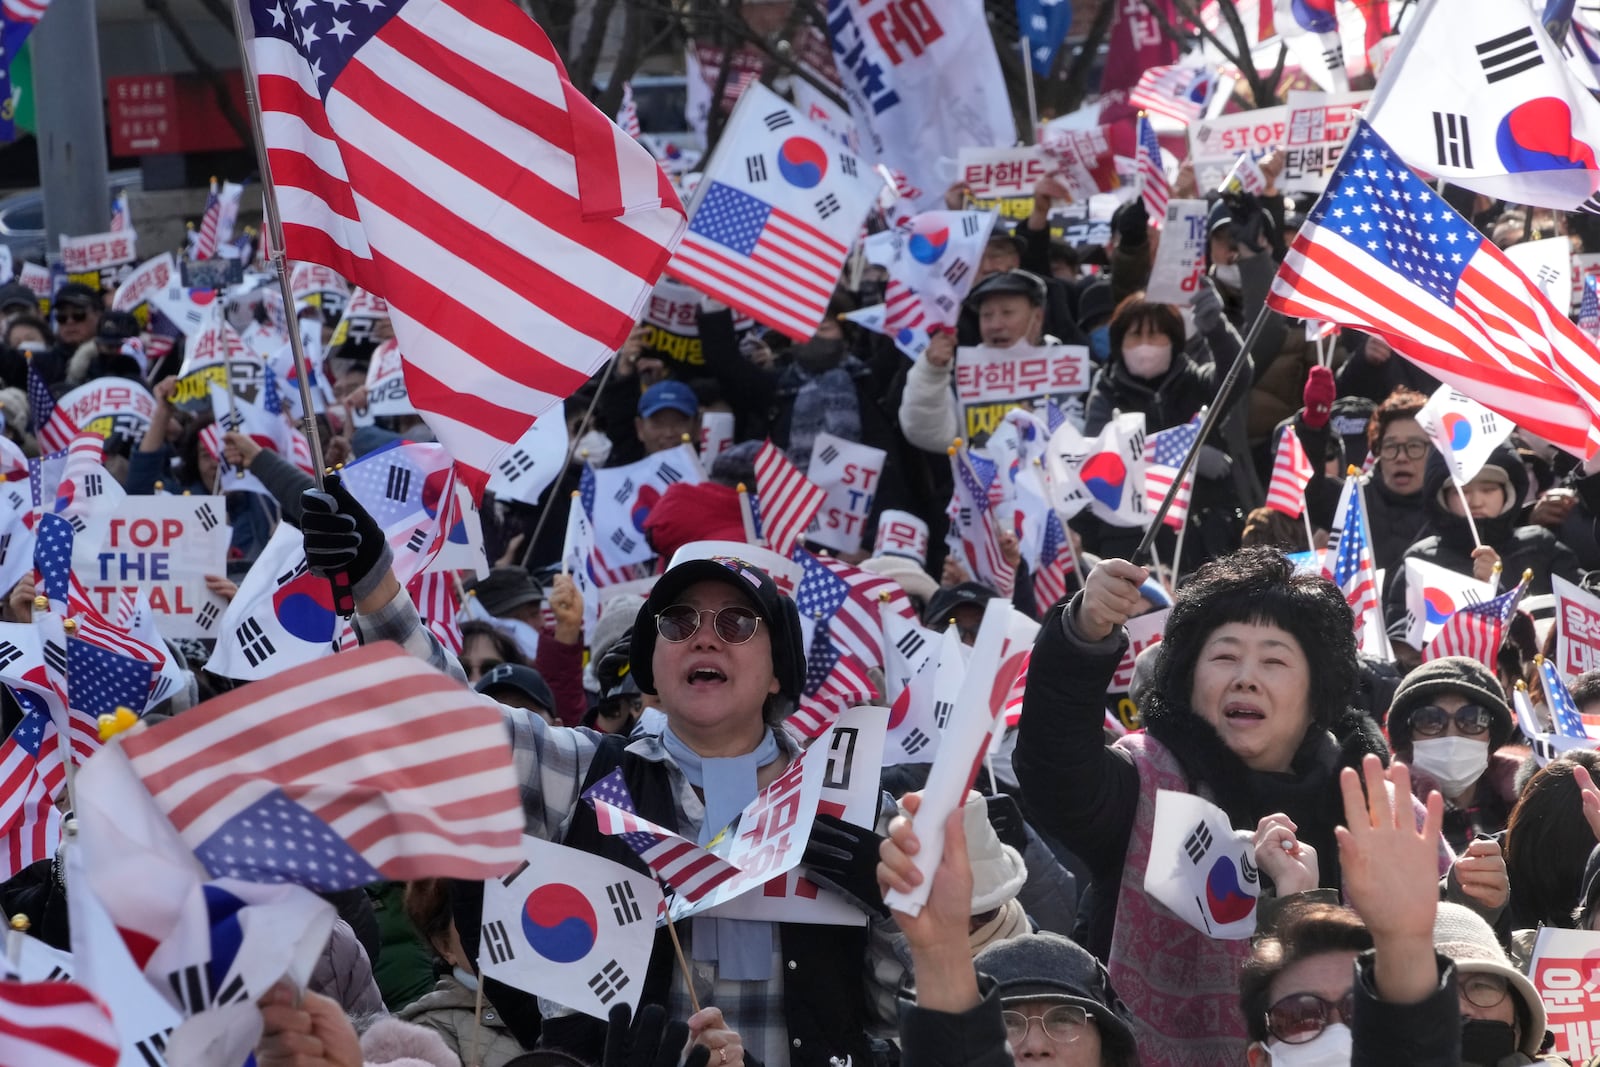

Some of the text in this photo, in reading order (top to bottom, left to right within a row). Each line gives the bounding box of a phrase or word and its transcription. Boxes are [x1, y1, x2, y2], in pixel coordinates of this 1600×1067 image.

[1221, 123, 1285, 149] STOP
[957, 355, 1082, 398] 탄핵무효
[110, 518, 184, 548] TOP
[97, 553, 170, 581] THE
[1569, 639, 1600, 673] 대
[1546, 1020, 1600, 1062] 대
